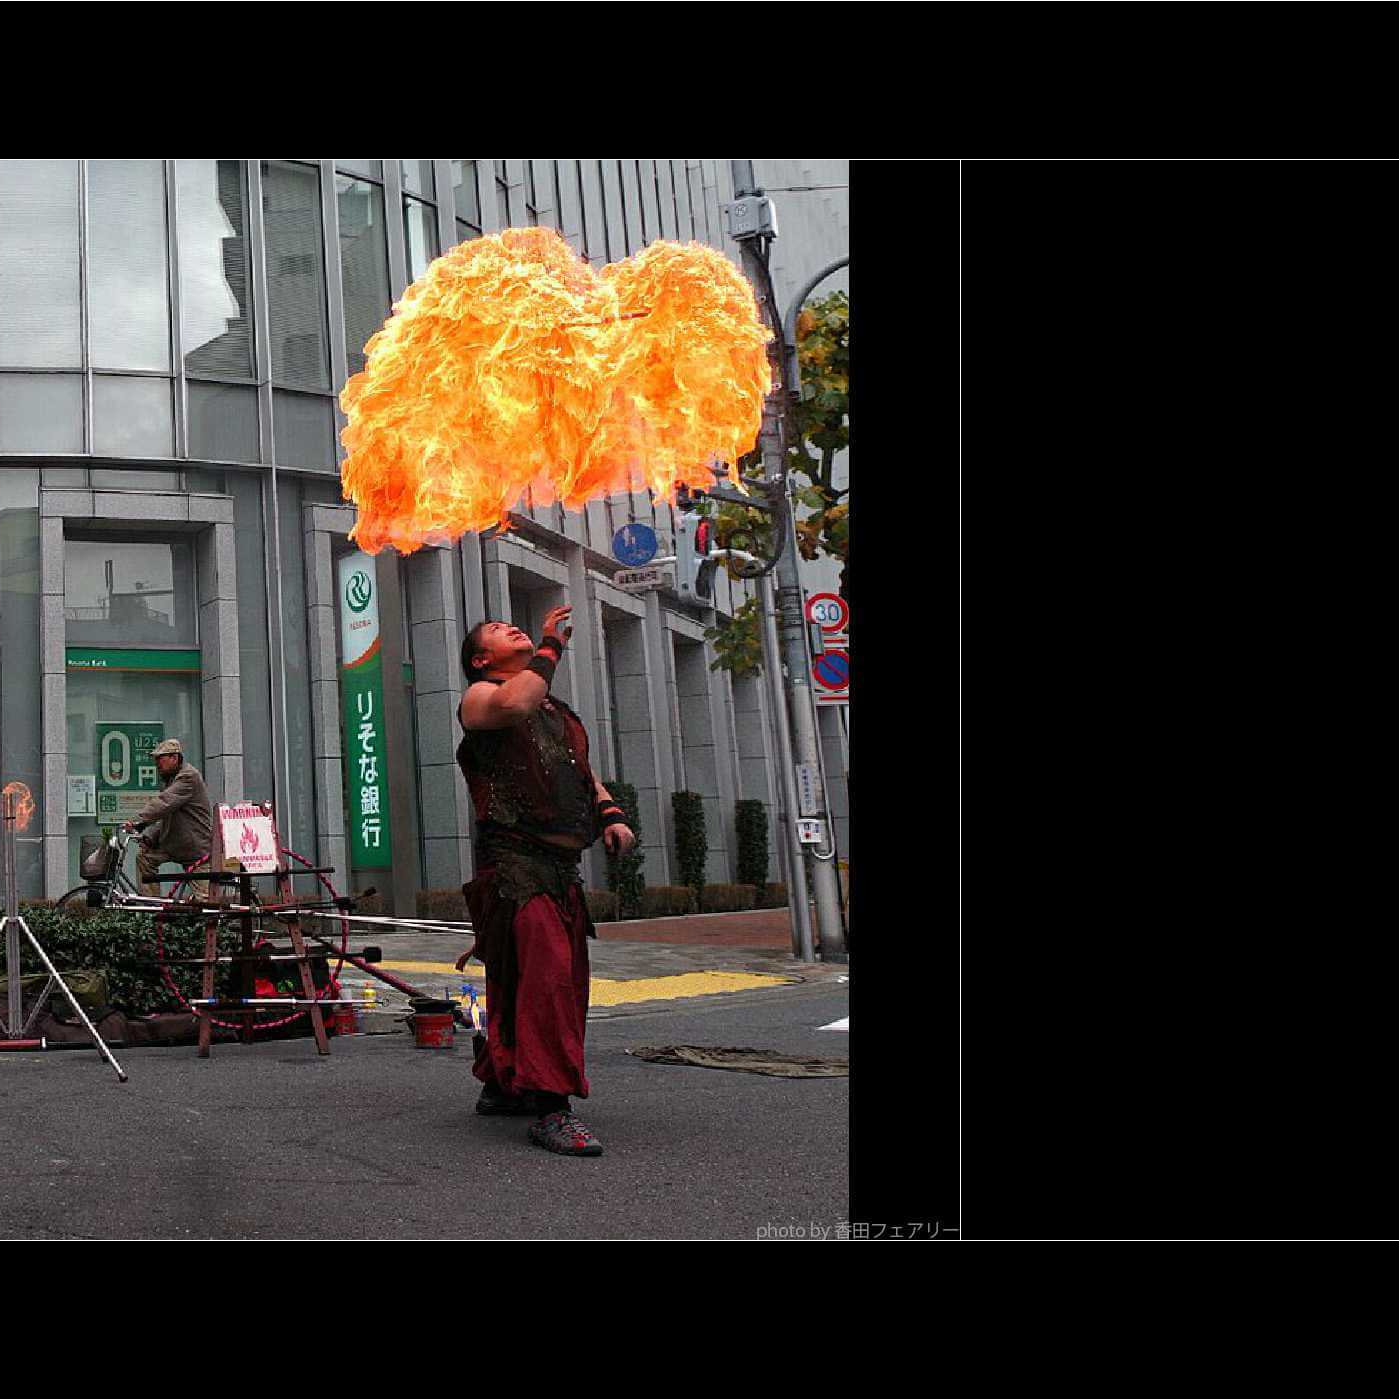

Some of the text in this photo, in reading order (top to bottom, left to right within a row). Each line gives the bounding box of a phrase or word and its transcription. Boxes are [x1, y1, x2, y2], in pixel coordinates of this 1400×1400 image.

[815, 603, 840, 621] 30
[357, 690, 381, 848] りそな銀行
